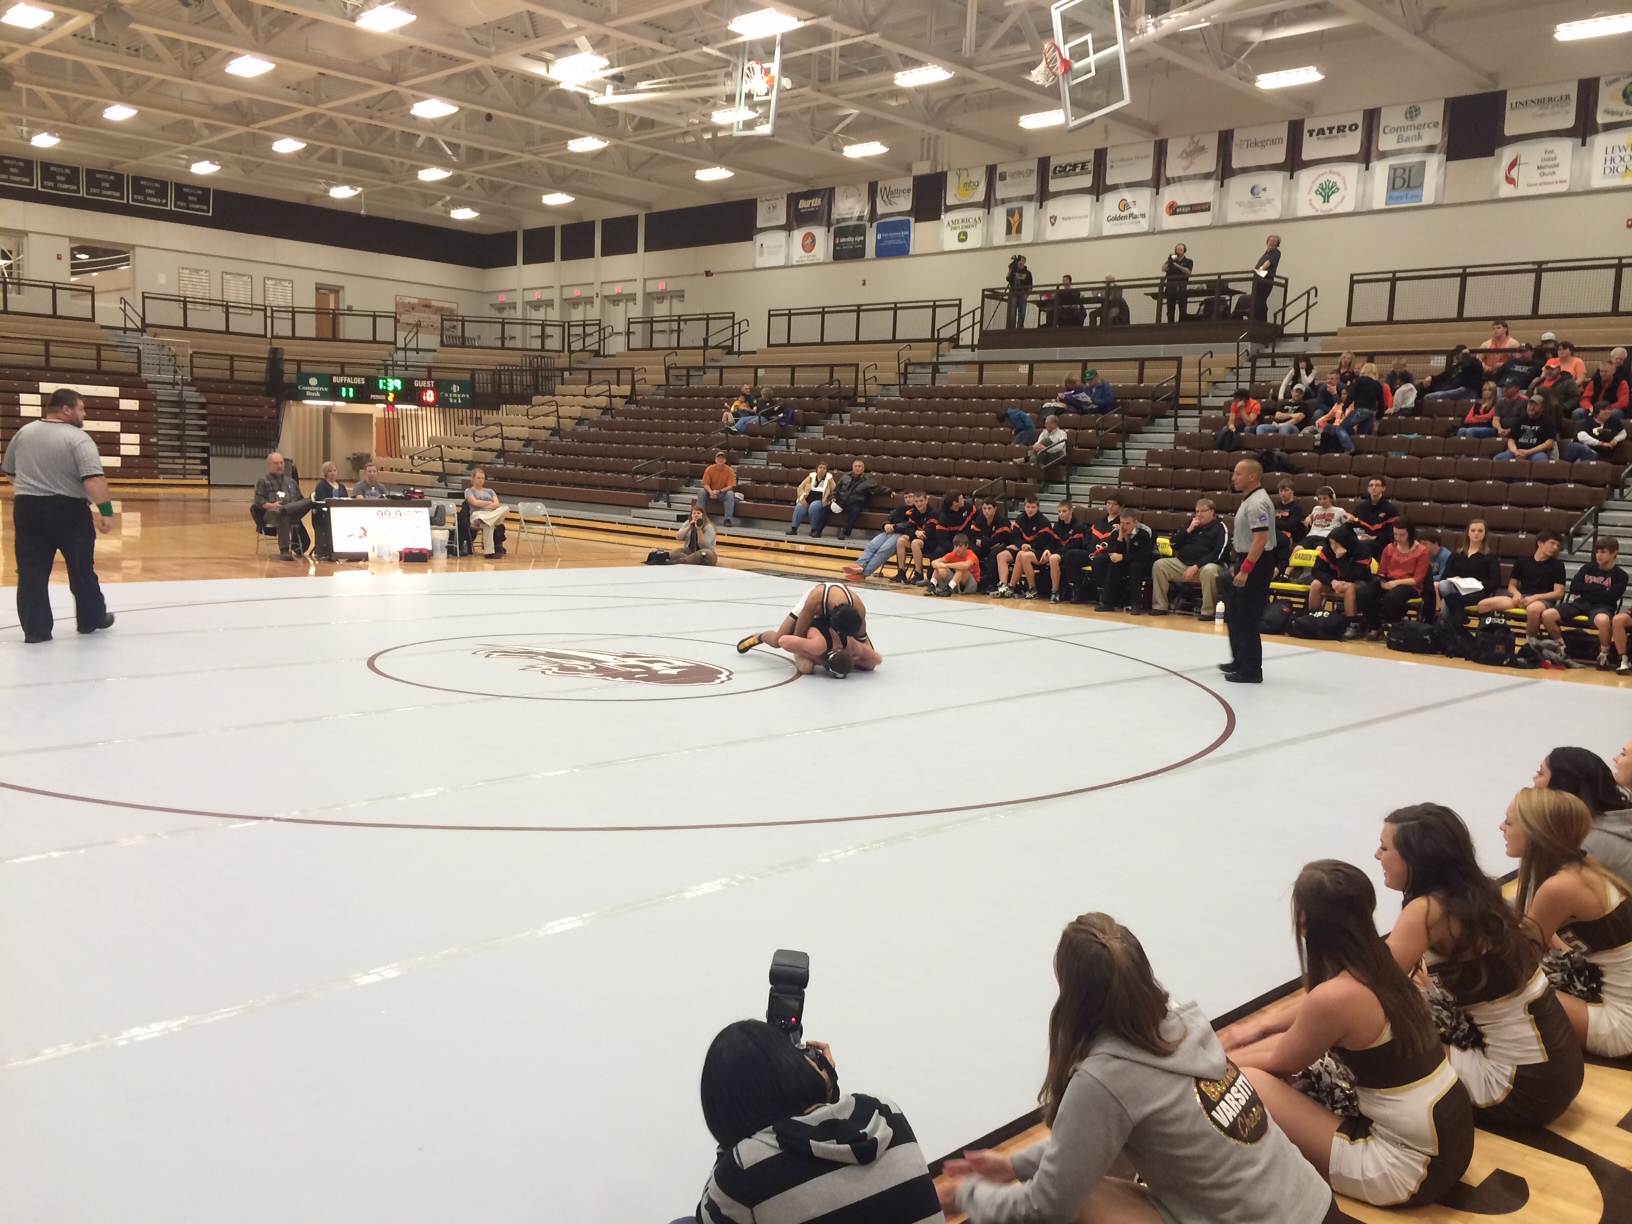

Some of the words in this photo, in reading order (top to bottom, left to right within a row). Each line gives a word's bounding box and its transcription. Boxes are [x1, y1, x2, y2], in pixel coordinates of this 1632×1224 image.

[1510, 94, 1571, 108] LINENBERGER
[1306, 122, 1359, 138] TATRO
[1382, 120, 1439, 135] Commerce
[1244, 137, 1284, 149] Telegram
[1396, 132, 1423, 144] Bank
[1052, 160, 1091, 175] GCFE
[1392, 165, 1422, 190] BL
[1539, 170, 1556, 178] Church
[963, 179, 980, 188] mba
[880, 186, 912, 202] Wallace
[1405, 192, 1420, 200] Law
[946, 216, 982, 228] AMERICAN
[1106, 213, 1128, 222] Golden
[1128, 212, 1146, 221] Plains
[332, 376, 365, 384] BUFFALOES
[378, 379, 402, 391] 1:39
[414, 380, 435, 388] GUEST
[341, 387, 354, 398] 11
[388, 392, 394, 402] 2
[1294, 553, 1312, 561] GARDEN
[1238, 1104, 1263, 1138] Cheer
